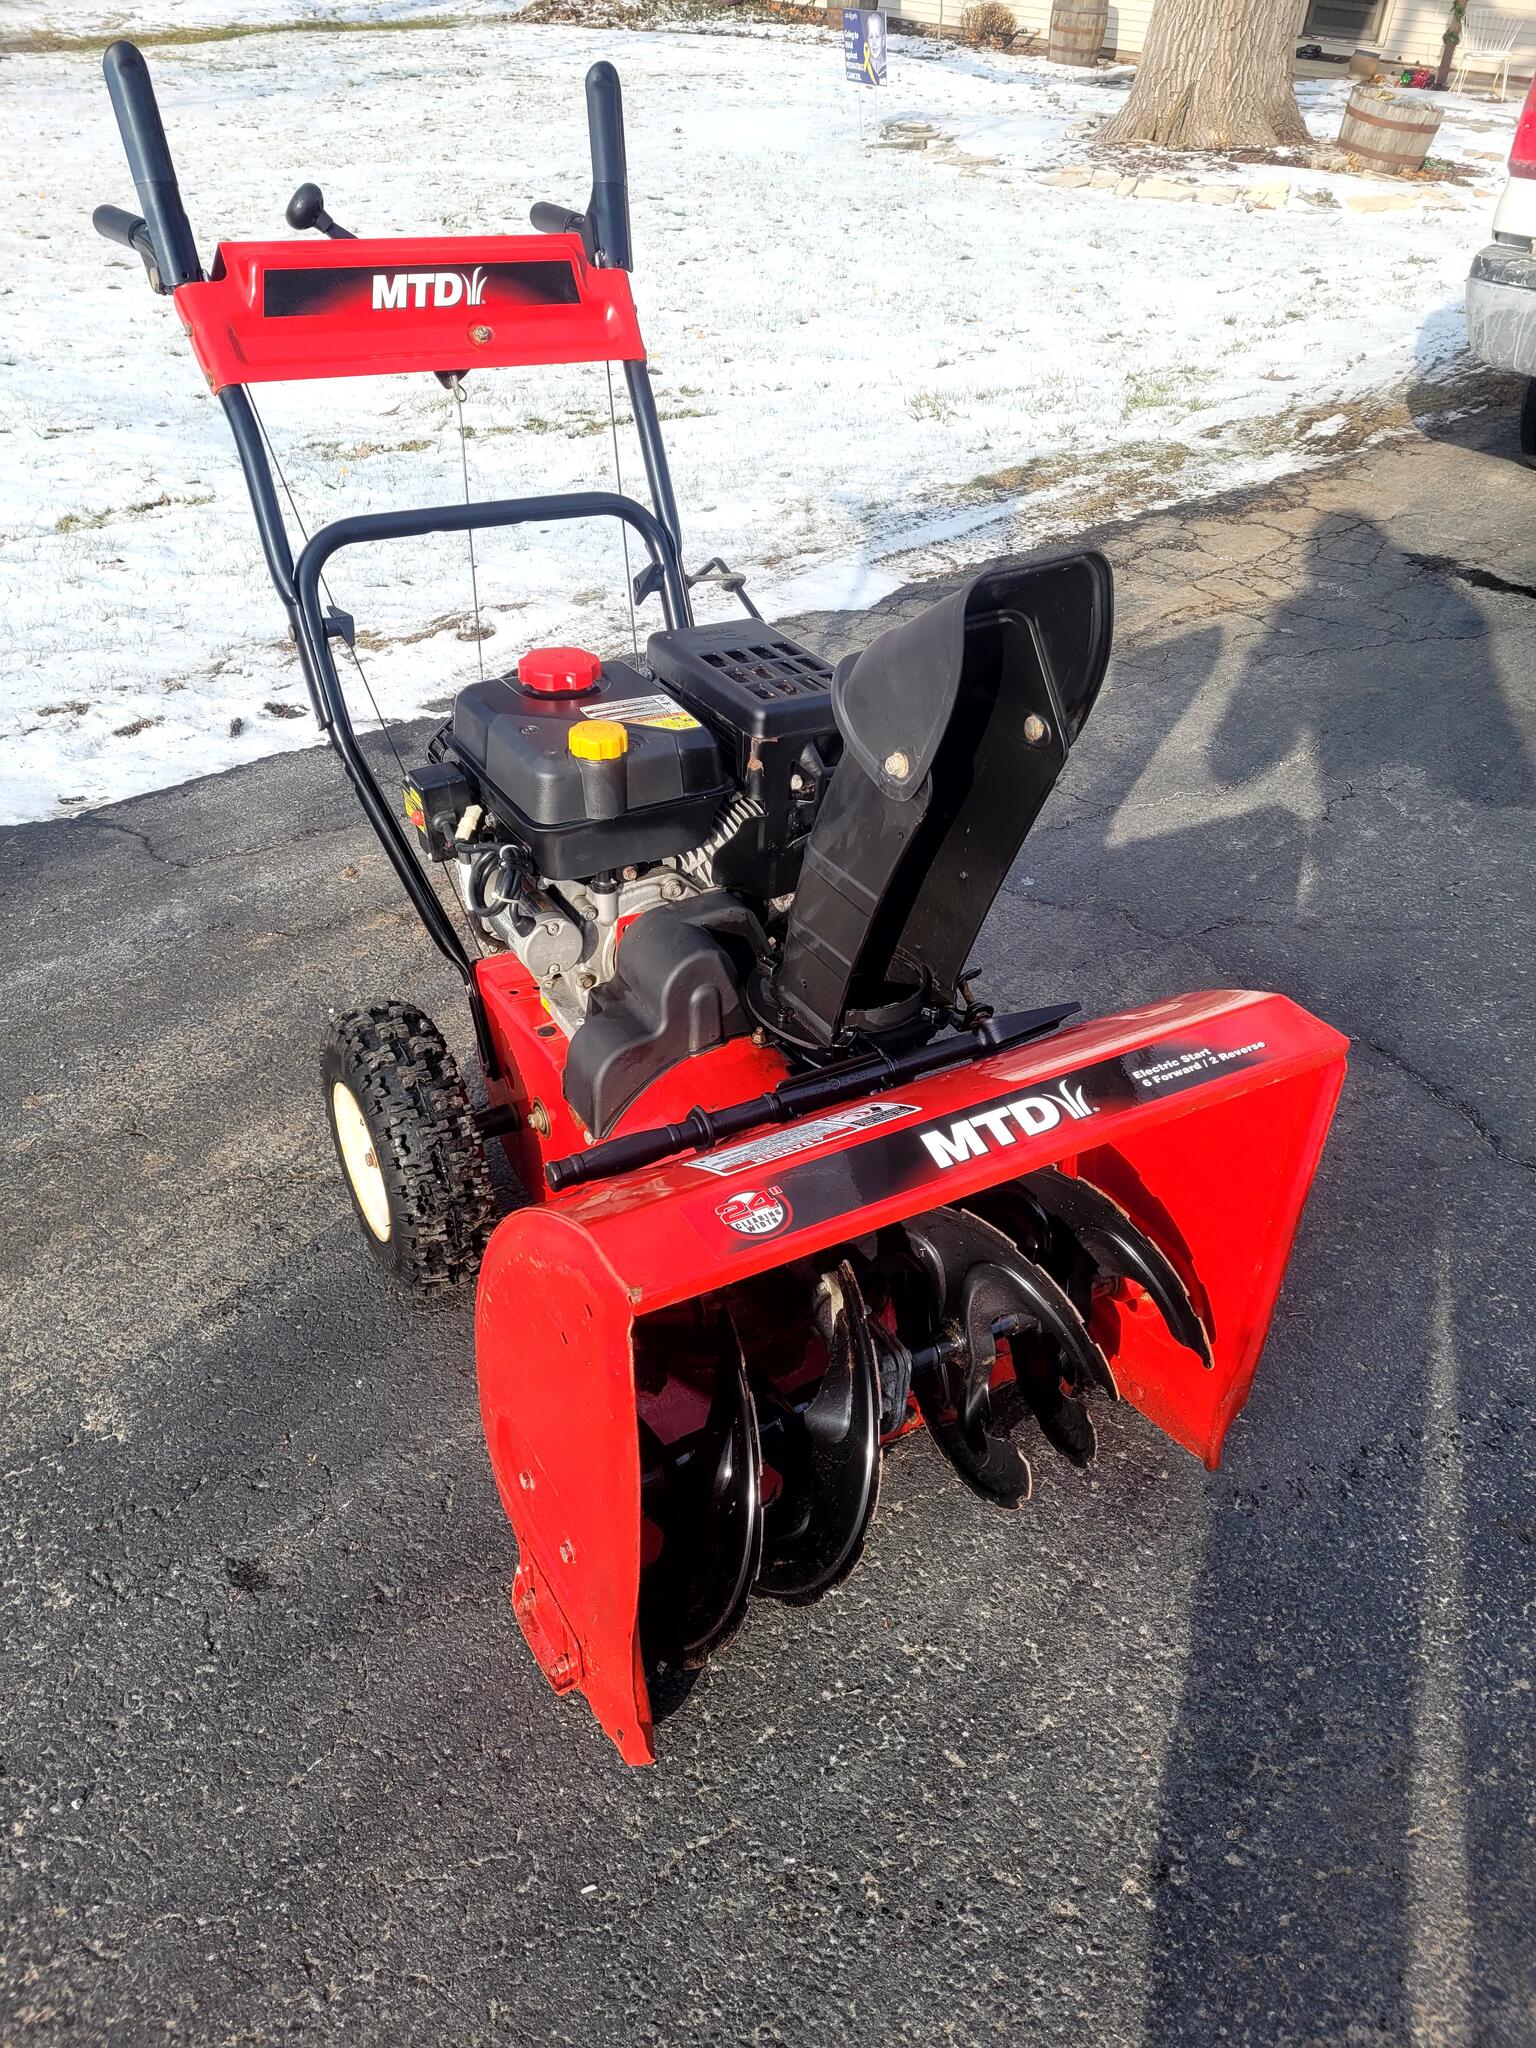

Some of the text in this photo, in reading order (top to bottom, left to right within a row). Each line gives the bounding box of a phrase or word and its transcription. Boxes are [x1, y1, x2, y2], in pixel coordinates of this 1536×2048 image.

[371, 272, 463, 310] MTD
[1131, 1047, 1212, 1080] Electric Start
[1142, 1078, 1153, 1087] 6
[1152, 1061, 1203, 1084] Forward
[1208, 1055, 1220, 1065] 2
[1217, 1041, 1266, 1061] Reverse
[919, 1097, 1061, 1169] MTD
[734, 1209, 782, 1230] CLEARING
[746, 1217, 780, 1233] WIDTH
